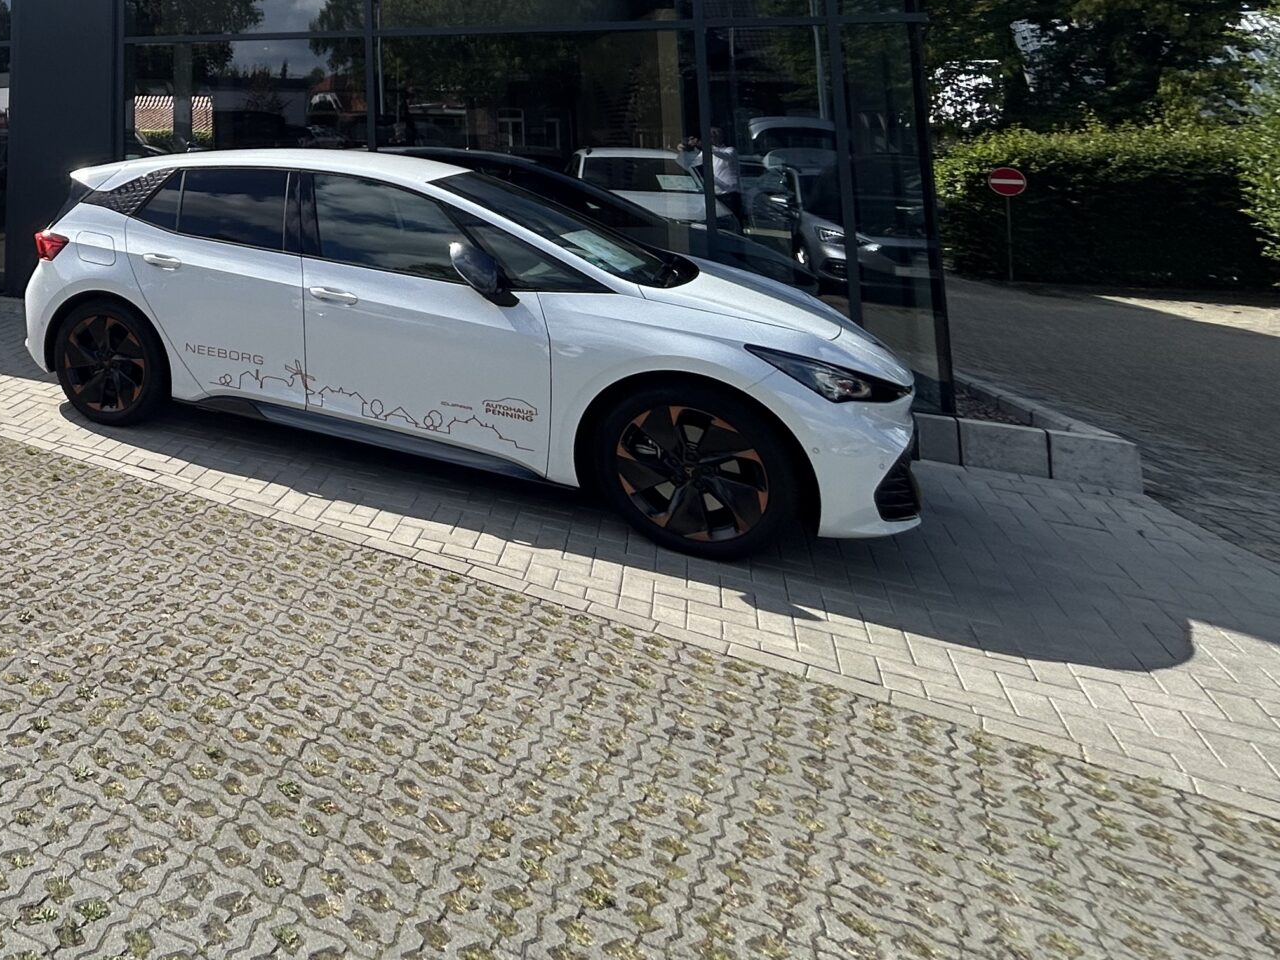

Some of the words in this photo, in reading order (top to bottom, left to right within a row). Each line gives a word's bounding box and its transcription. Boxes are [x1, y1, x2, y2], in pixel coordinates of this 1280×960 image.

[185, 342, 264, 366] NEEBORG
[485, 402, 535, 416] AUTOHAUS
[485, 407, 534, 423] PENNING
